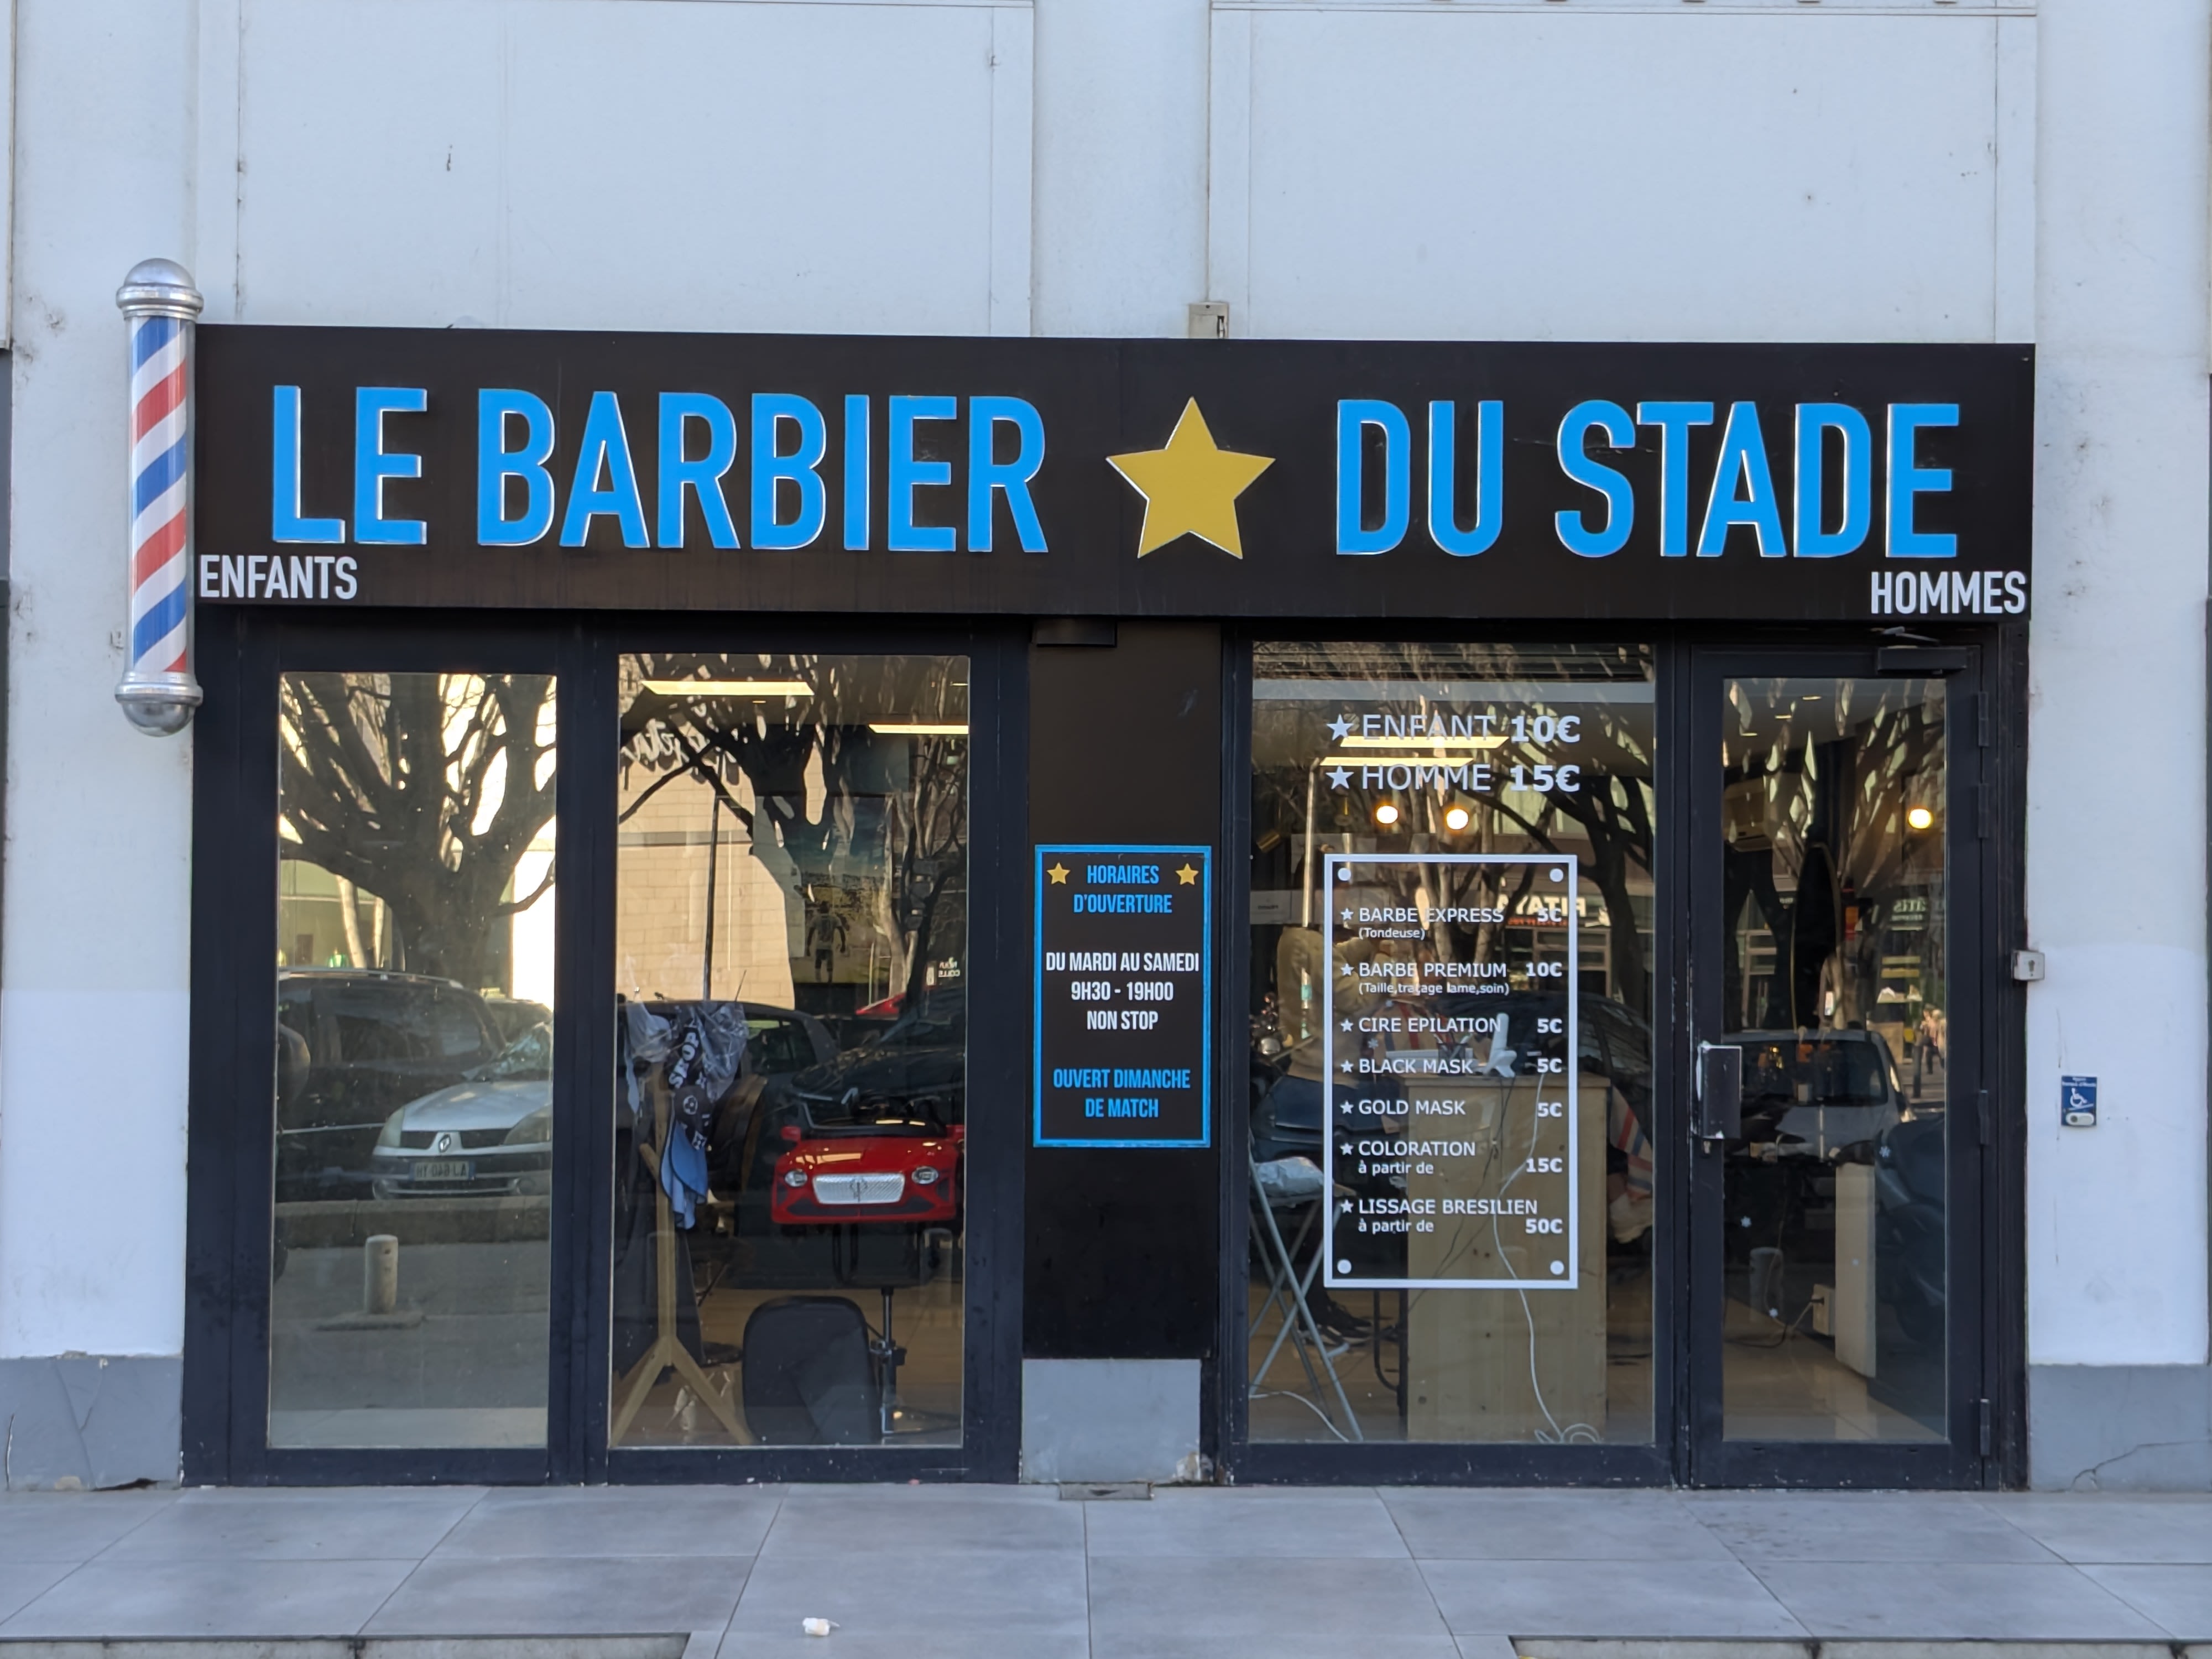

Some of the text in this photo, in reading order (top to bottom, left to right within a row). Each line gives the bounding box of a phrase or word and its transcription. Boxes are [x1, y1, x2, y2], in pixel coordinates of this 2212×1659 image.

[273, 385, 1960, 558] LE BARBIER DU STADE
[200, 554, 358, 599] ENFANTS
[1870, 570, 2027, 615] HOMMES
[1362, 714, 1582, 743] ENFANT 10€
[1362, 764, 1582, 792] HOMME 15€
[1087, 865, 1159, 884] HORAIRES
[1073, 894, 1173, 914] D'OUVERTURE
[1359, 907, 1418, 922] BARBE
[1425, 907, 1504, 922] EXPRESS
[1358, 927, 1426, 940] (Tondeuse)
[1046, 952, 1199, 972] DU MARDI AU SAMEDI
[1359, 963, 1417, 978] BARBE
[1423, 963, 1507, 978] PREMIUM
[1071, 982, 1111, 1001] 9H30
[1126, 982, 1174, 1001] 19H00
[1087, 1010, 1159, 1030] NON STOP
[1358, 1018, 1401, 1033] CIRE
[1407, 1018, 1501, 1033] EPILATION
[1359, 1058, 1416, 1073] BLACK
[1423, 1058, 1473, 1073] MASK
[1053, 1068, 1191, 1088] OUVERT DIMANCHE
[1085, 1098, 1159, 1118] DE MATCH
[1358, 1100, 1409, 1115] GOLD
[1415, 1100, 1466, 1115] MASK
[1358, 1141, 1476, 1156] COLORATION
[1358, 1160, 1434, 1176] à partir de
[1358, 1199, 1538, 1215] LISSAGE BRESILIEN
[1358, 1218, 1434, 1234] à partir de
